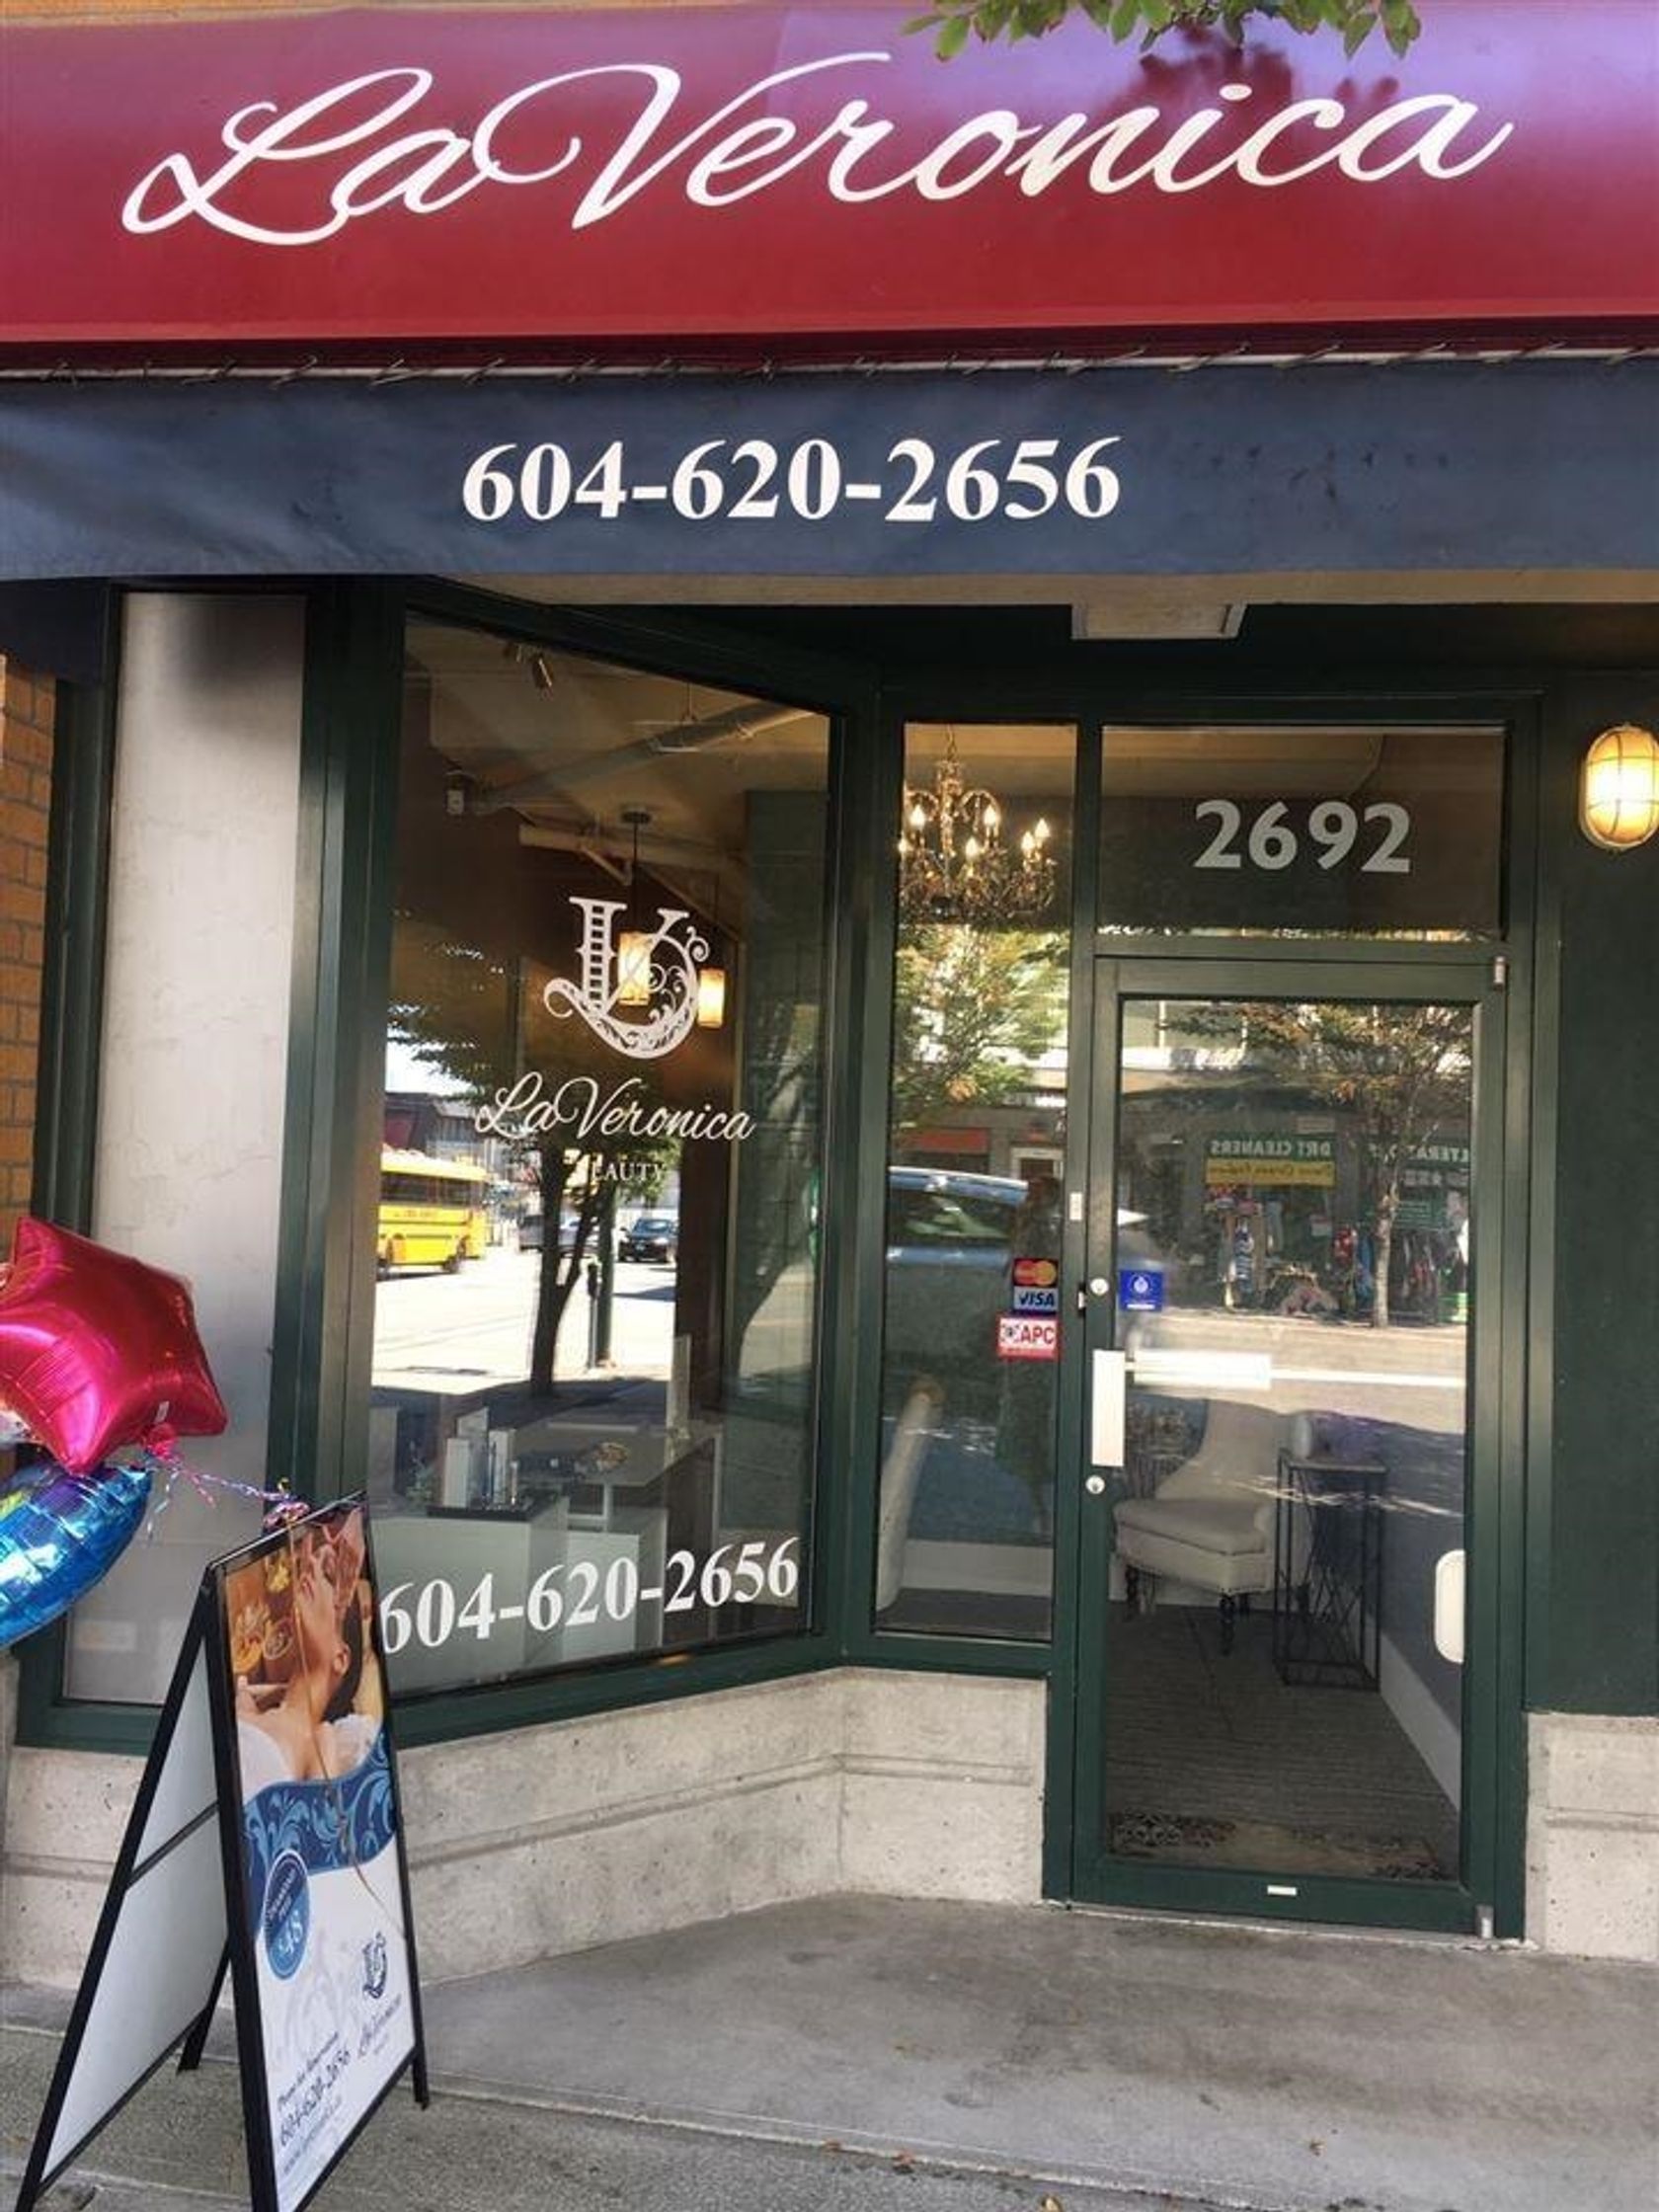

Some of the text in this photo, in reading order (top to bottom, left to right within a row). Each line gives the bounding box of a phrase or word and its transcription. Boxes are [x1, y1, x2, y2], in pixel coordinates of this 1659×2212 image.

[462, 437, 1122, 521] 604-620-2656
[1193, 799, 1412, 873] 2692
[1019, 1292, 1056, 1307] VISA
[379, 1537, 801, 1655] 604-620-2656
